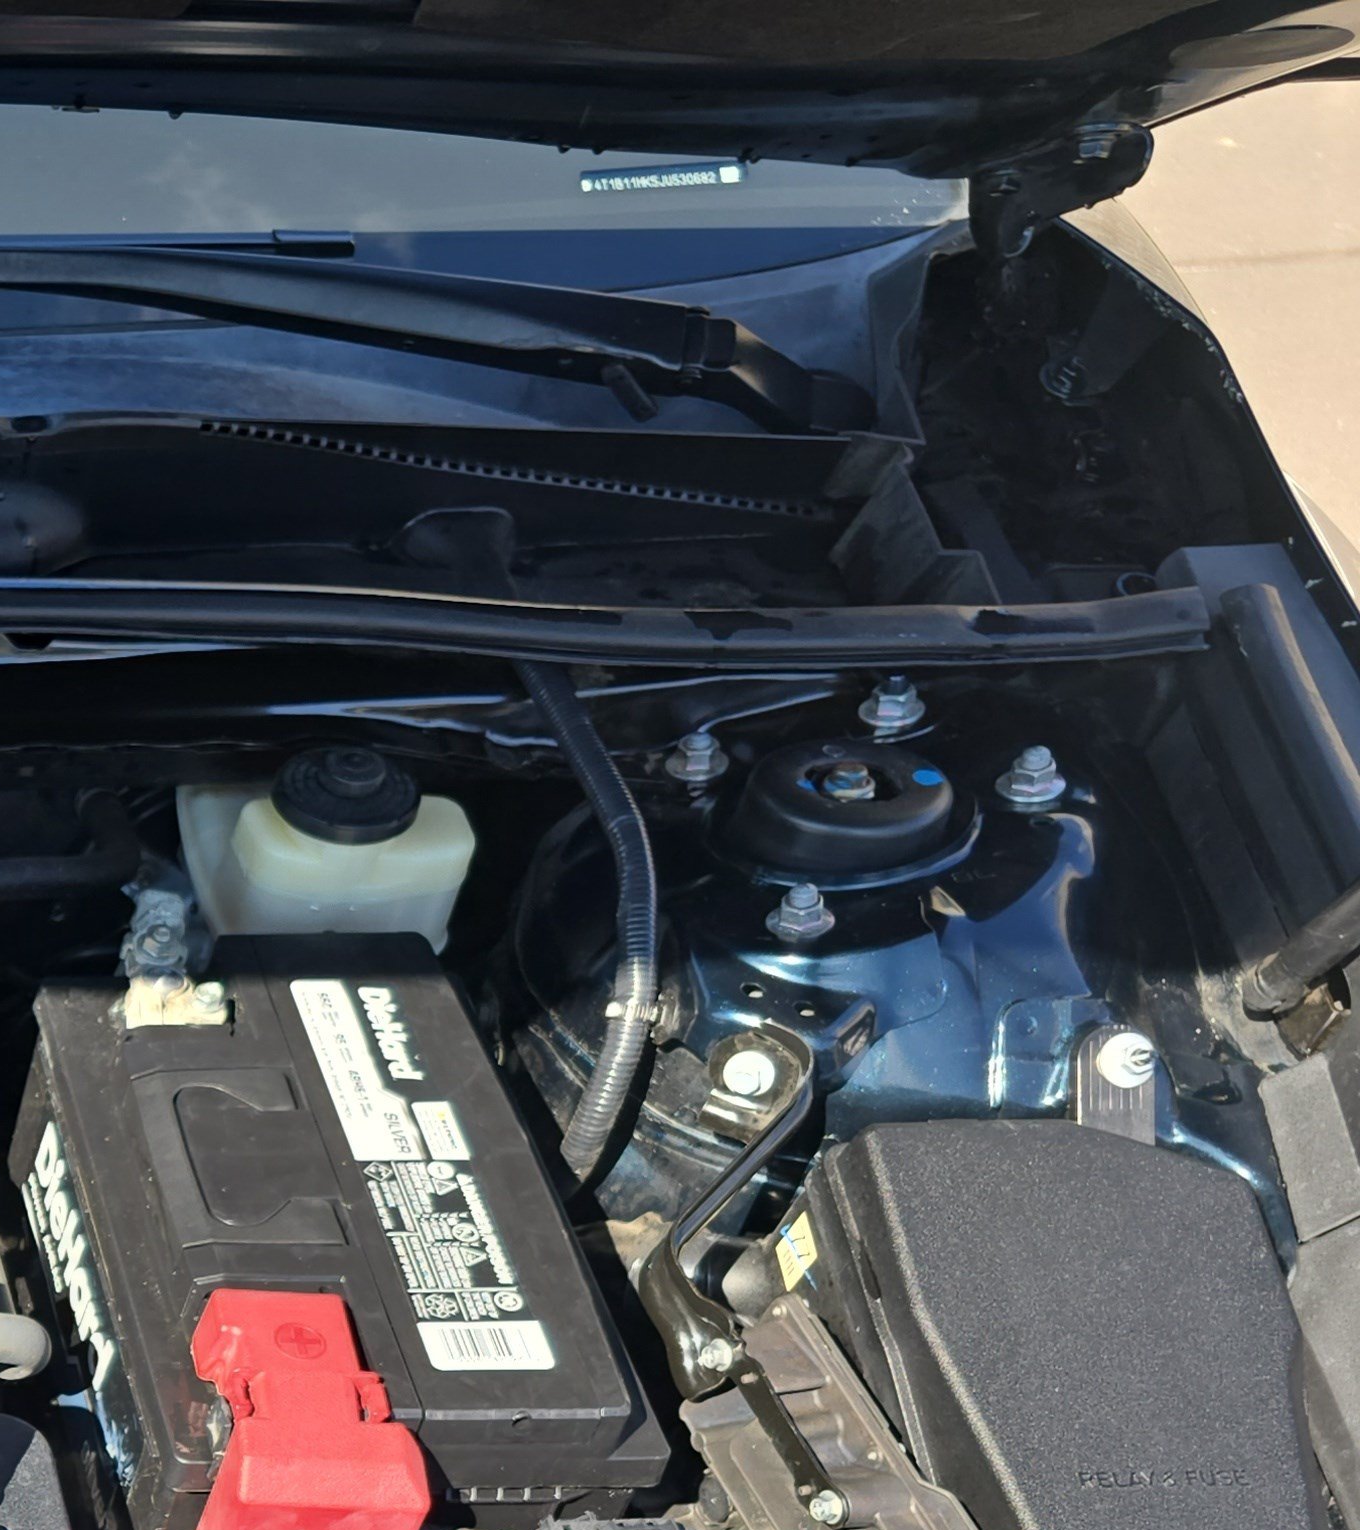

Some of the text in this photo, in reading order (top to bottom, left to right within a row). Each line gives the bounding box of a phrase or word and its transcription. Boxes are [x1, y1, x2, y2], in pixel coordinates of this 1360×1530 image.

[357, 986, 423, 1081] DieHard
[383, 1112, 412, 1154] SILVER
[1078, 1471, 1155, 1488] RELAY
[1186, 1469, 1250, 1487] FUSE
